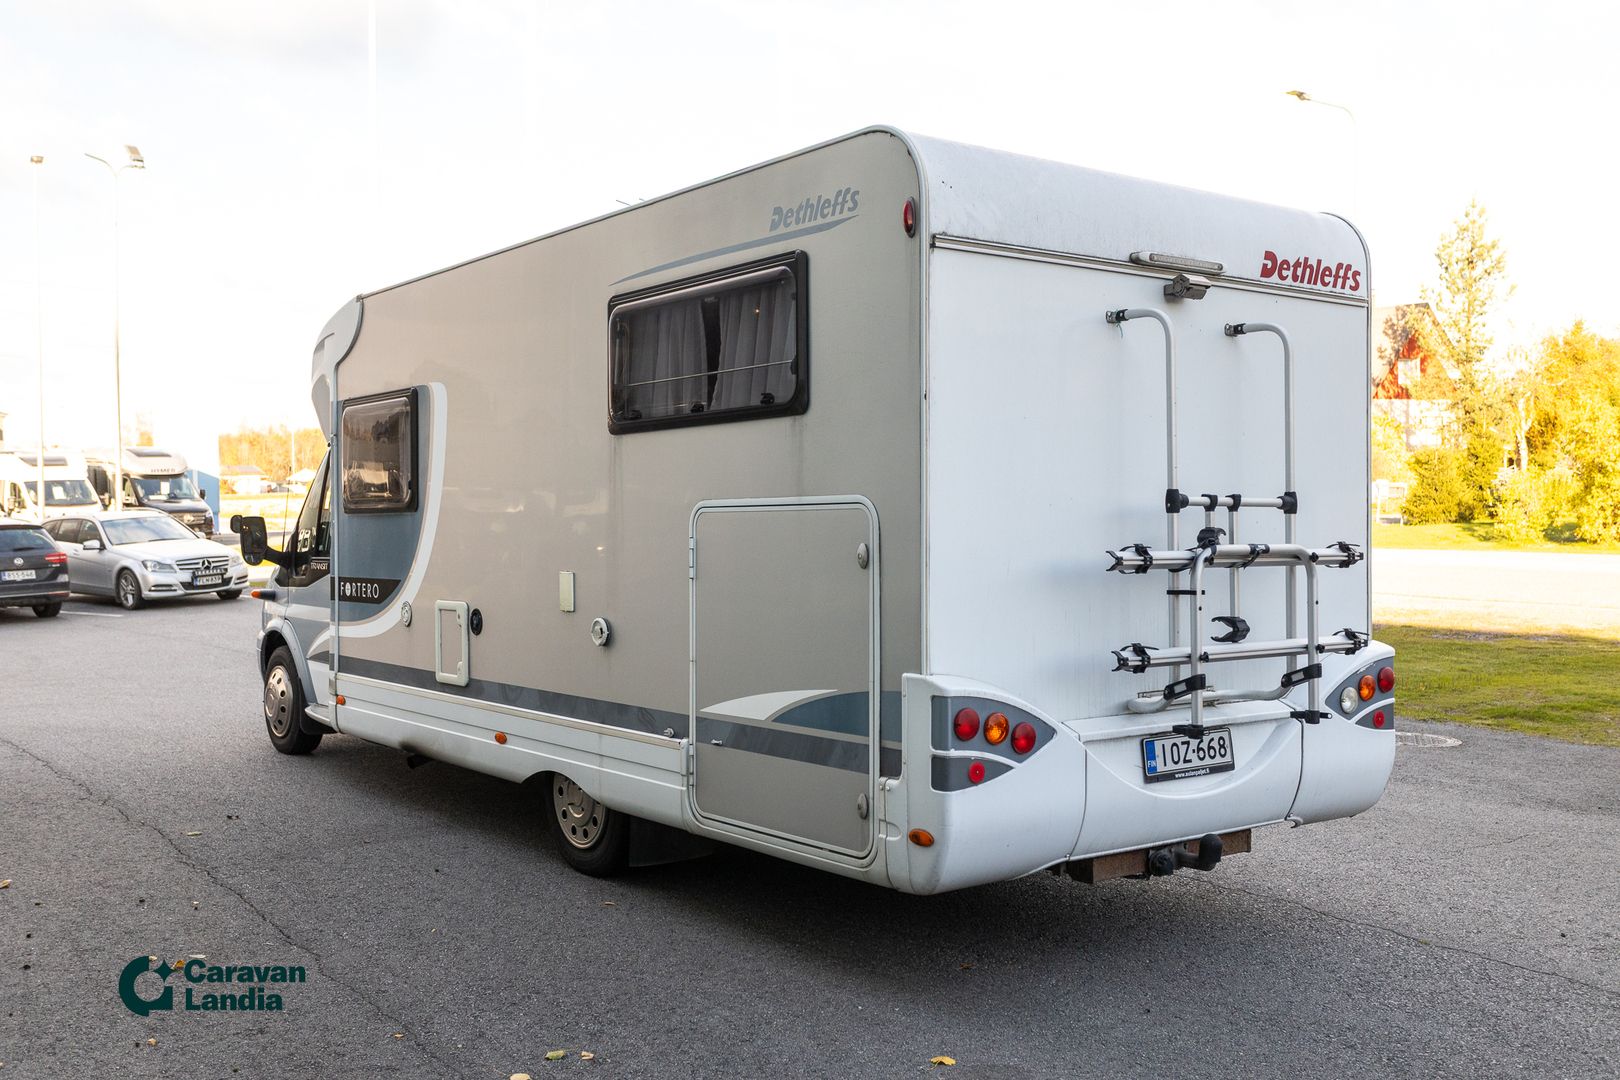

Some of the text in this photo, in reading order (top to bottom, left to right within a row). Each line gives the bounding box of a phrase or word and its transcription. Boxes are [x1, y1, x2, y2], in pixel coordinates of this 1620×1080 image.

[769, 187, 860, 232] Dethleffs
[1260, 250, 1361, 292] Dethleffs
[340, 582, 380, 599] FORTERO
[1147, 760, 1157, 768] FIN
[1162, 736, 1227, 767] IOZ-668
